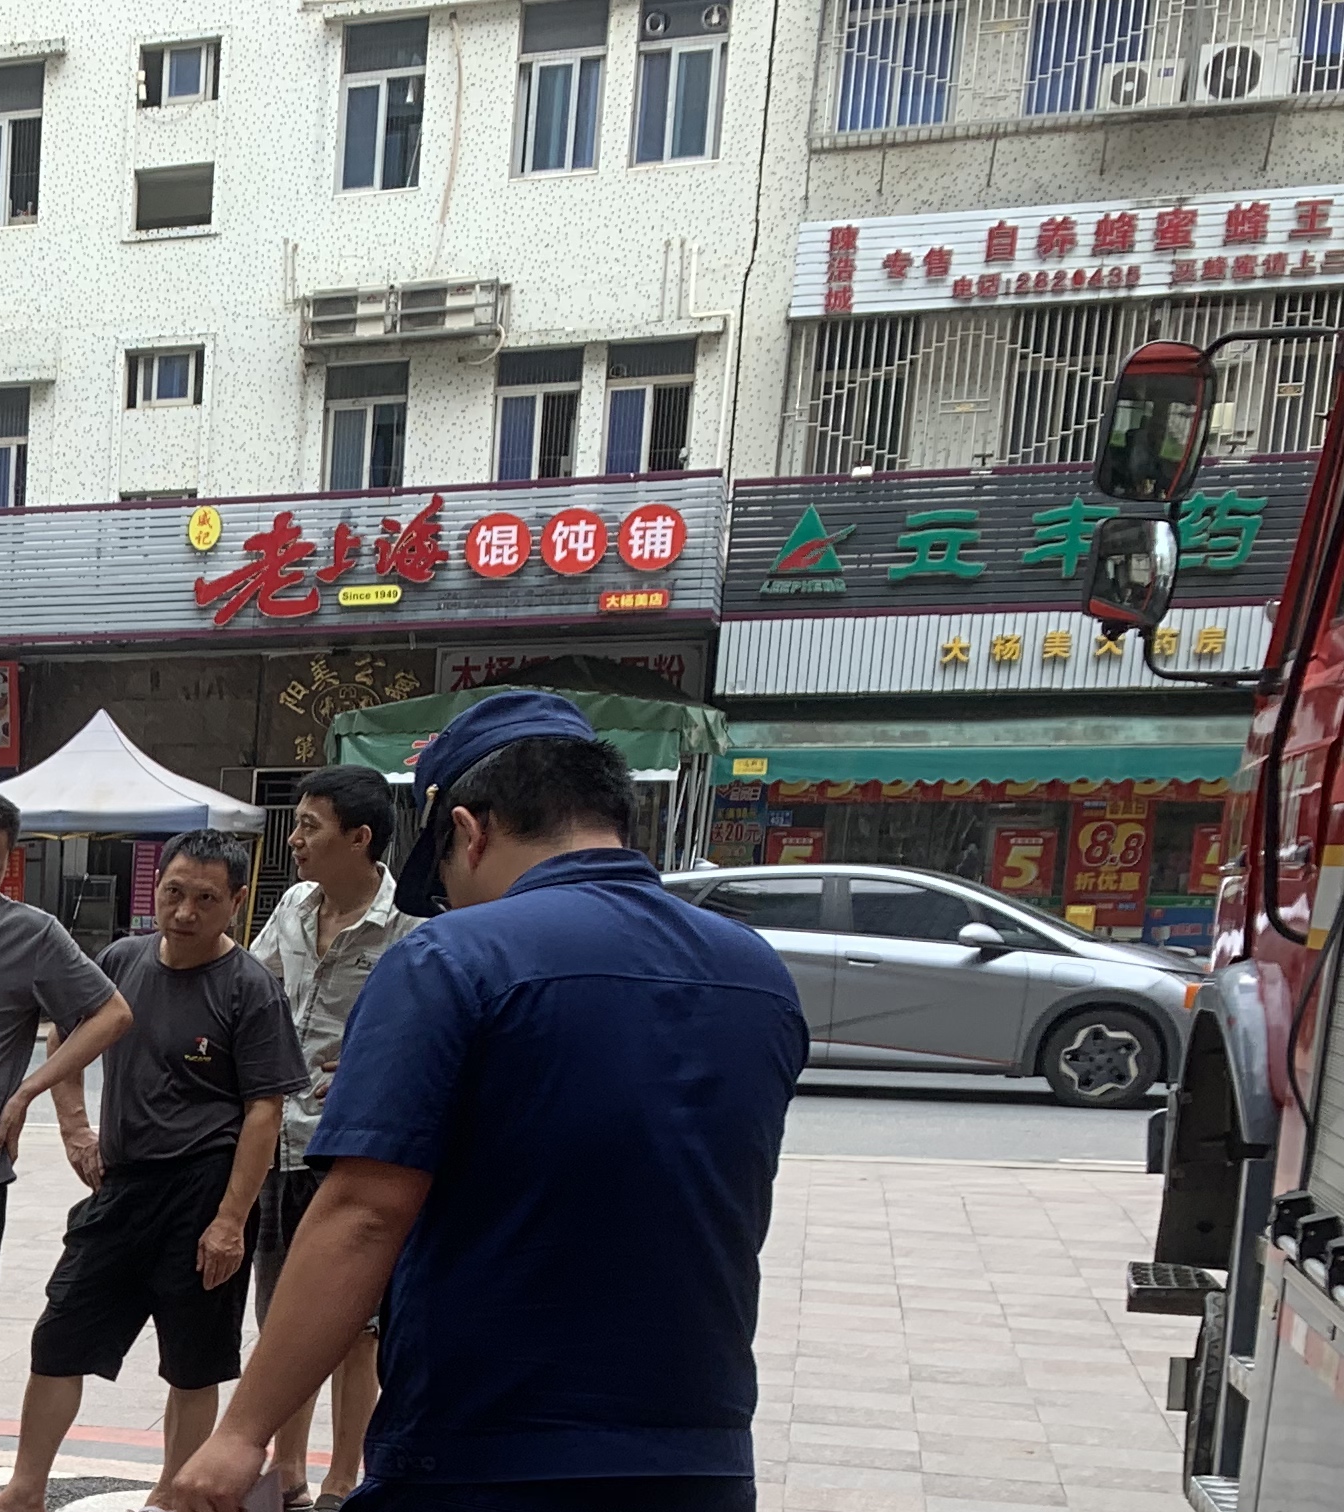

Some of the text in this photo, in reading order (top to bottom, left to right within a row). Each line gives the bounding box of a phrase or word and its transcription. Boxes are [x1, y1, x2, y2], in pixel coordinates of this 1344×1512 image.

[882, 247, 954, 281] 专售
[194, 493, 450, 626] 老上海
[476, 515, 675, 567] 馄饨铺
[341, 588, 400, 603] Since 1949
[940, 625, 1227, 665] 大杨美大药房
[1083, 821, 1146, 867] 8.8
[1001, 845, 1044, 889] 5
[1075, 871, 1142, 892] 折优惠
